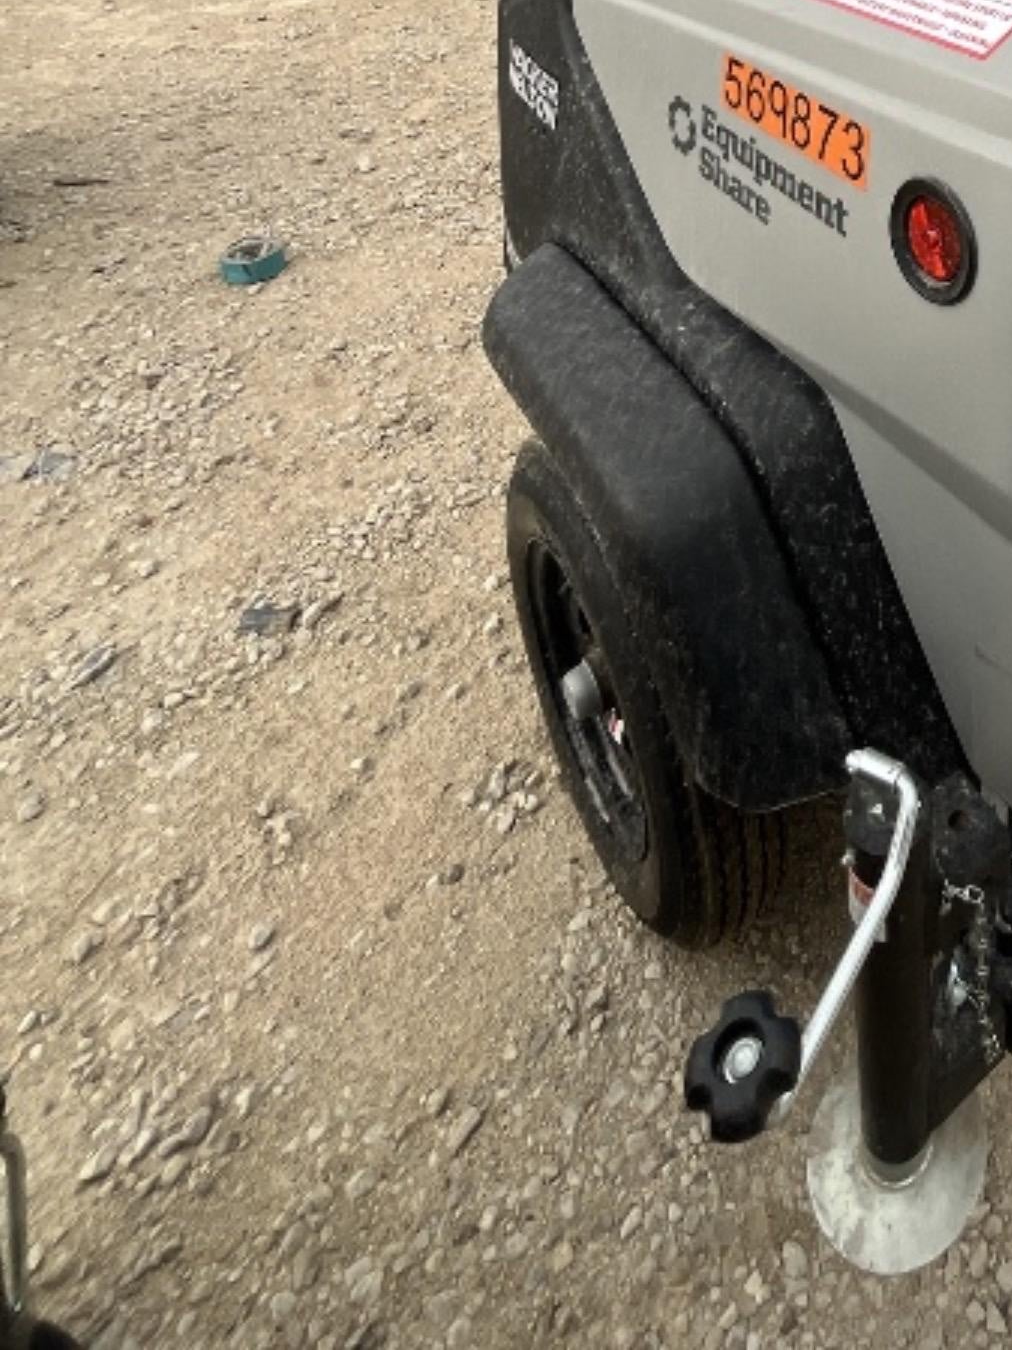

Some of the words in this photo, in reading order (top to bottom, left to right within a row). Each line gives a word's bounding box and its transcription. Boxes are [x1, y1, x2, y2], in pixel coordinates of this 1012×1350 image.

[701, 103, 849, 238] Equipment
[724, 56, 865, 182] 569873
[699, 146, 771, 226] Share
